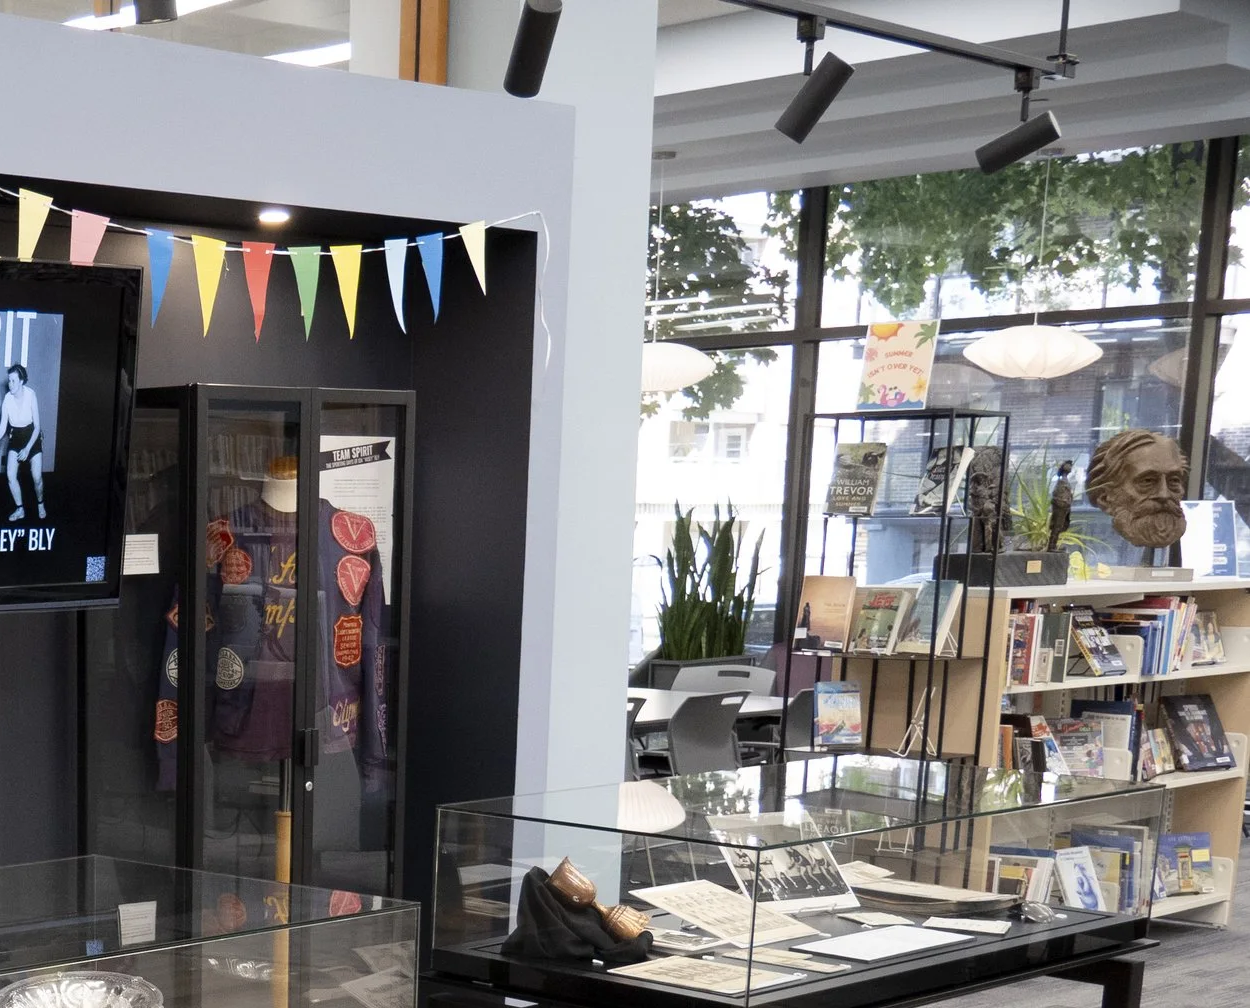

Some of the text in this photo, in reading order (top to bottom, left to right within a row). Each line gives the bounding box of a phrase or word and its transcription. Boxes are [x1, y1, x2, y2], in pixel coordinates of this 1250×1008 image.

[332, 445, 373, 462] TEAM SPIRIT
[830, 486, 873, 496] TREVOR
[28, 528, 56, 551] BLY
